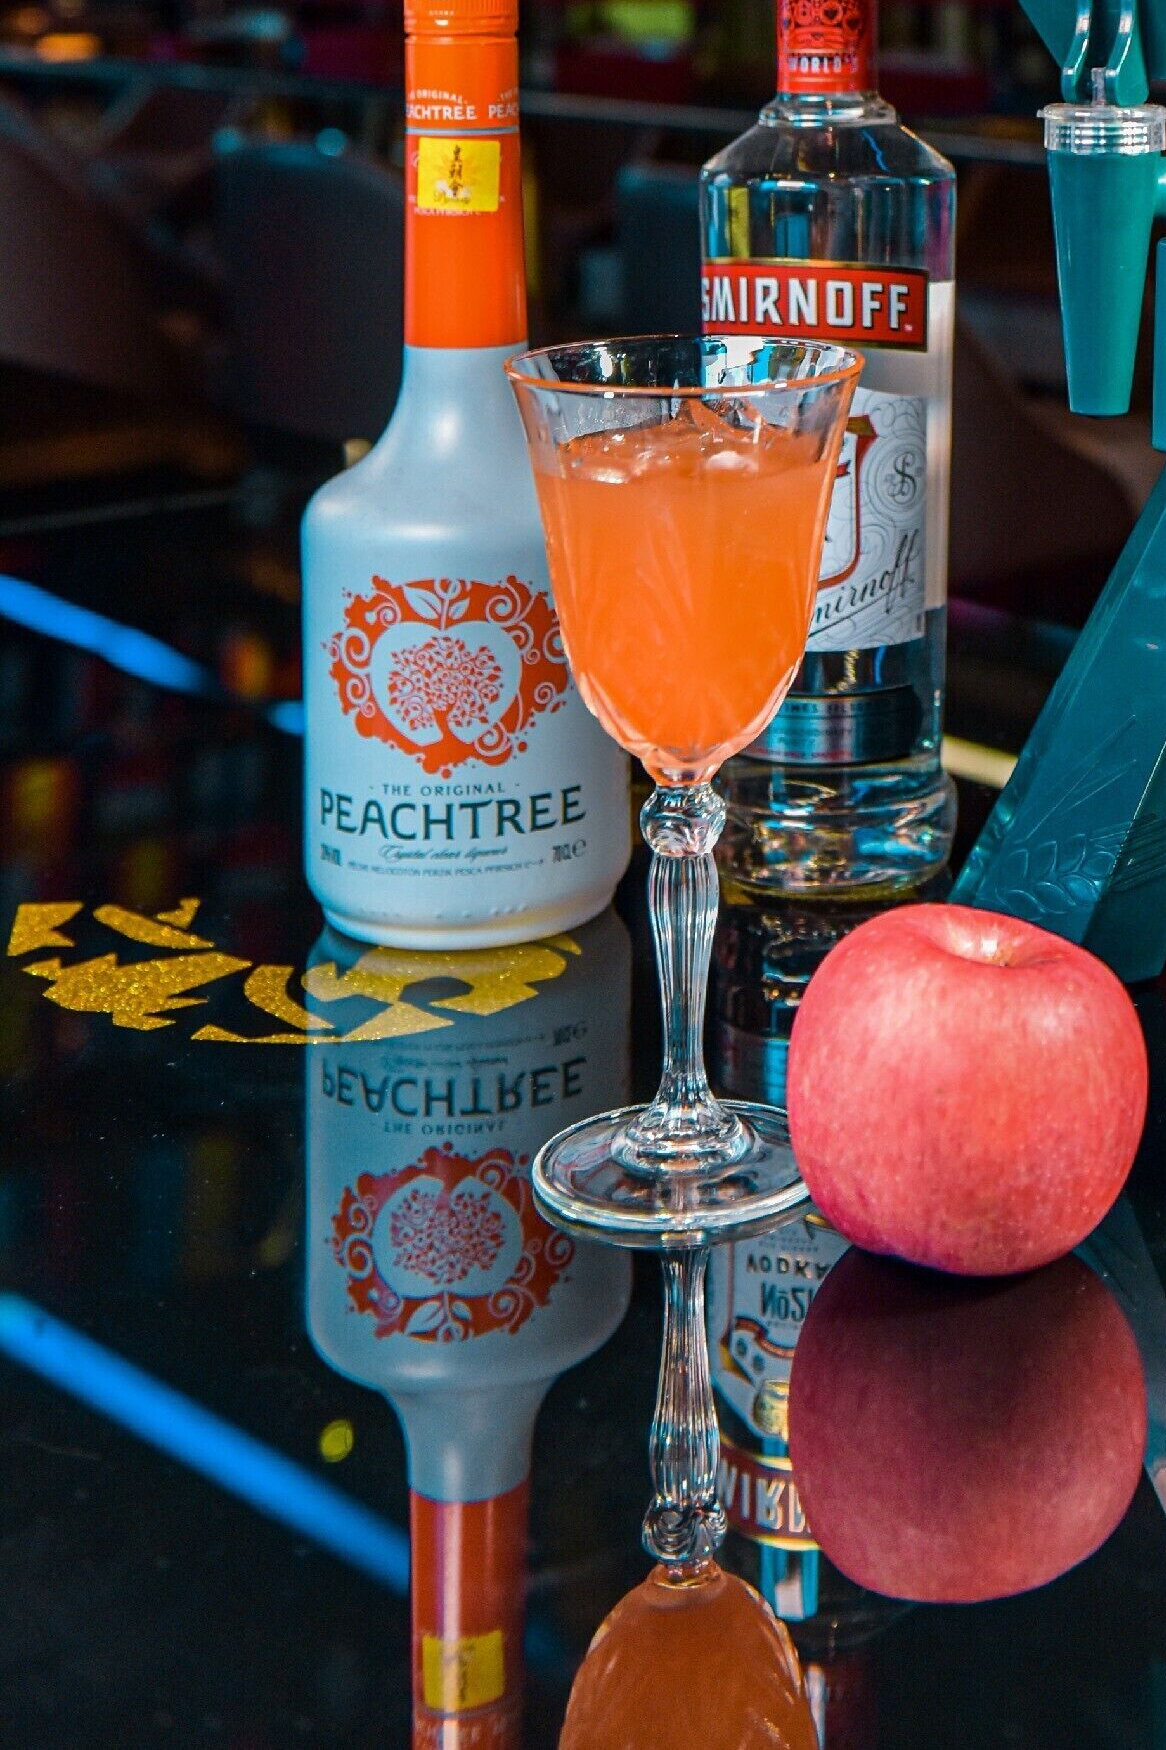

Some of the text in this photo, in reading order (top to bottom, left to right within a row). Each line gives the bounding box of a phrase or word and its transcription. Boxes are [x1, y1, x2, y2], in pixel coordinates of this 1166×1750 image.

[702, 276, 910, 330] SMIRNOFF
[813, 528, 921, 615] mirnoff
[320, 784, 587, 841] PEACHTREE
[383, 781, 505, 796] THE ORIGINAL
